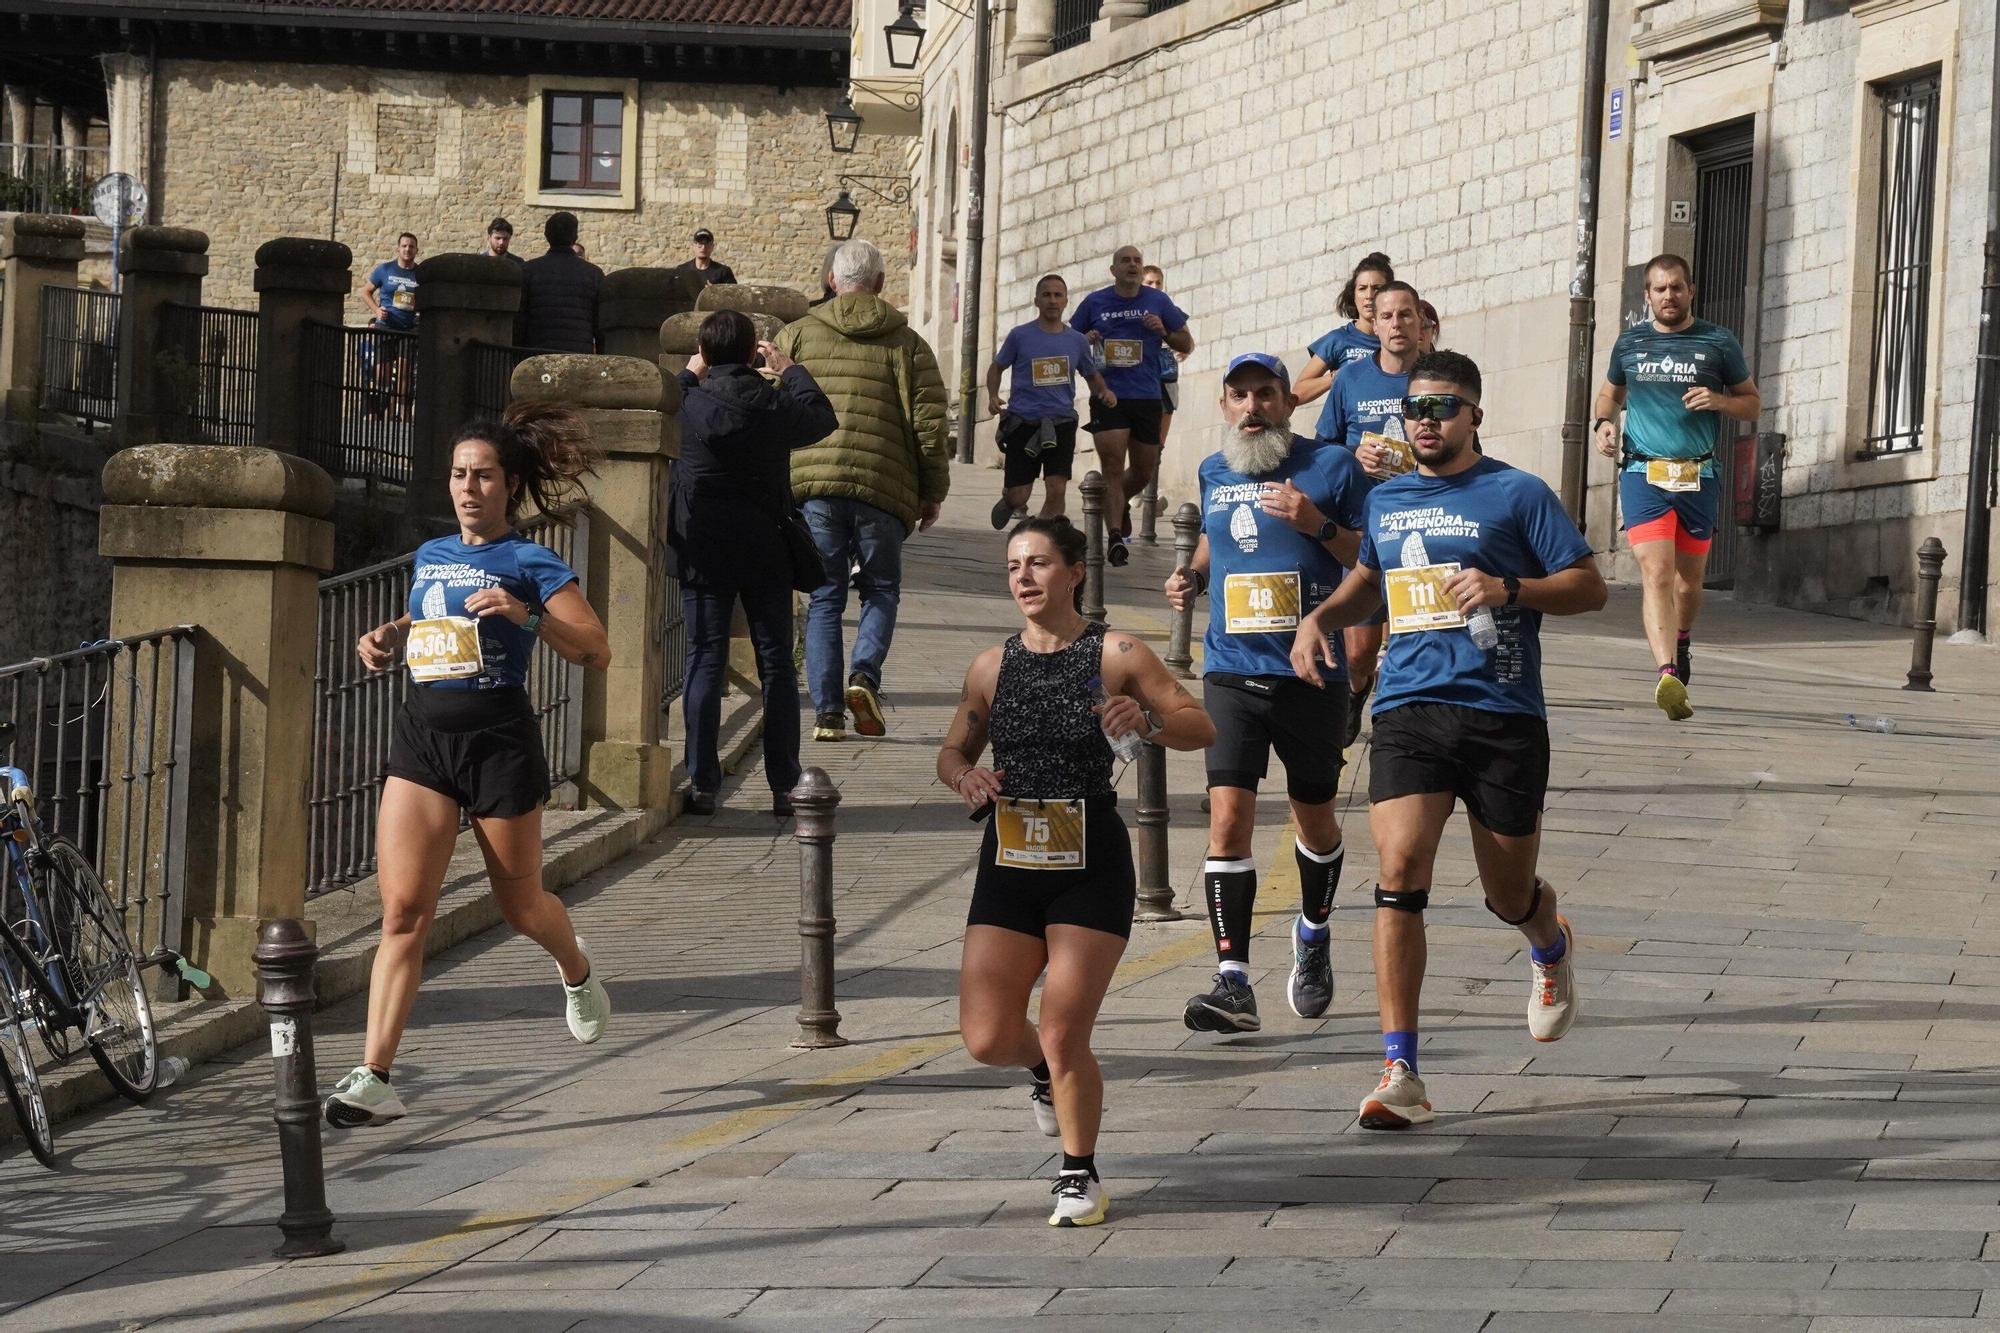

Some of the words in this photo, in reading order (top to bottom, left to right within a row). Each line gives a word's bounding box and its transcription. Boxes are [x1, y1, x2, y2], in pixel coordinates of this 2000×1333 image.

[1114, 346, 1133, 358] 592
[1671, 374, 1697, 383] TRAIL
[1367, 398, 1403, 407] CONQUI
[1219, 482, 1270, 493] CONQUIST
[1381, 514, 1390, 522] LA
[1390, 507, 1444, 520] CONQUISTA
[1389, 515, 1463, 531] ALMENDRA
[1425, 527, 1479, 538] KONKISTA
[423, 563, 470, 572] CONQUISTA
[418, 569, 485, 580] ALMENDRA
[486, 574, 501, 582] REN
[447, 578, 500, 589] KONKISTA
[1248, 588, 1273, 610] 48
[1408, 582, 1435, 607] 111
[424, 632, 458, 657] 364
[1023, 817, 1050, 843] 75
[1214, 879, 1226, 937] COMPRESSPORT
